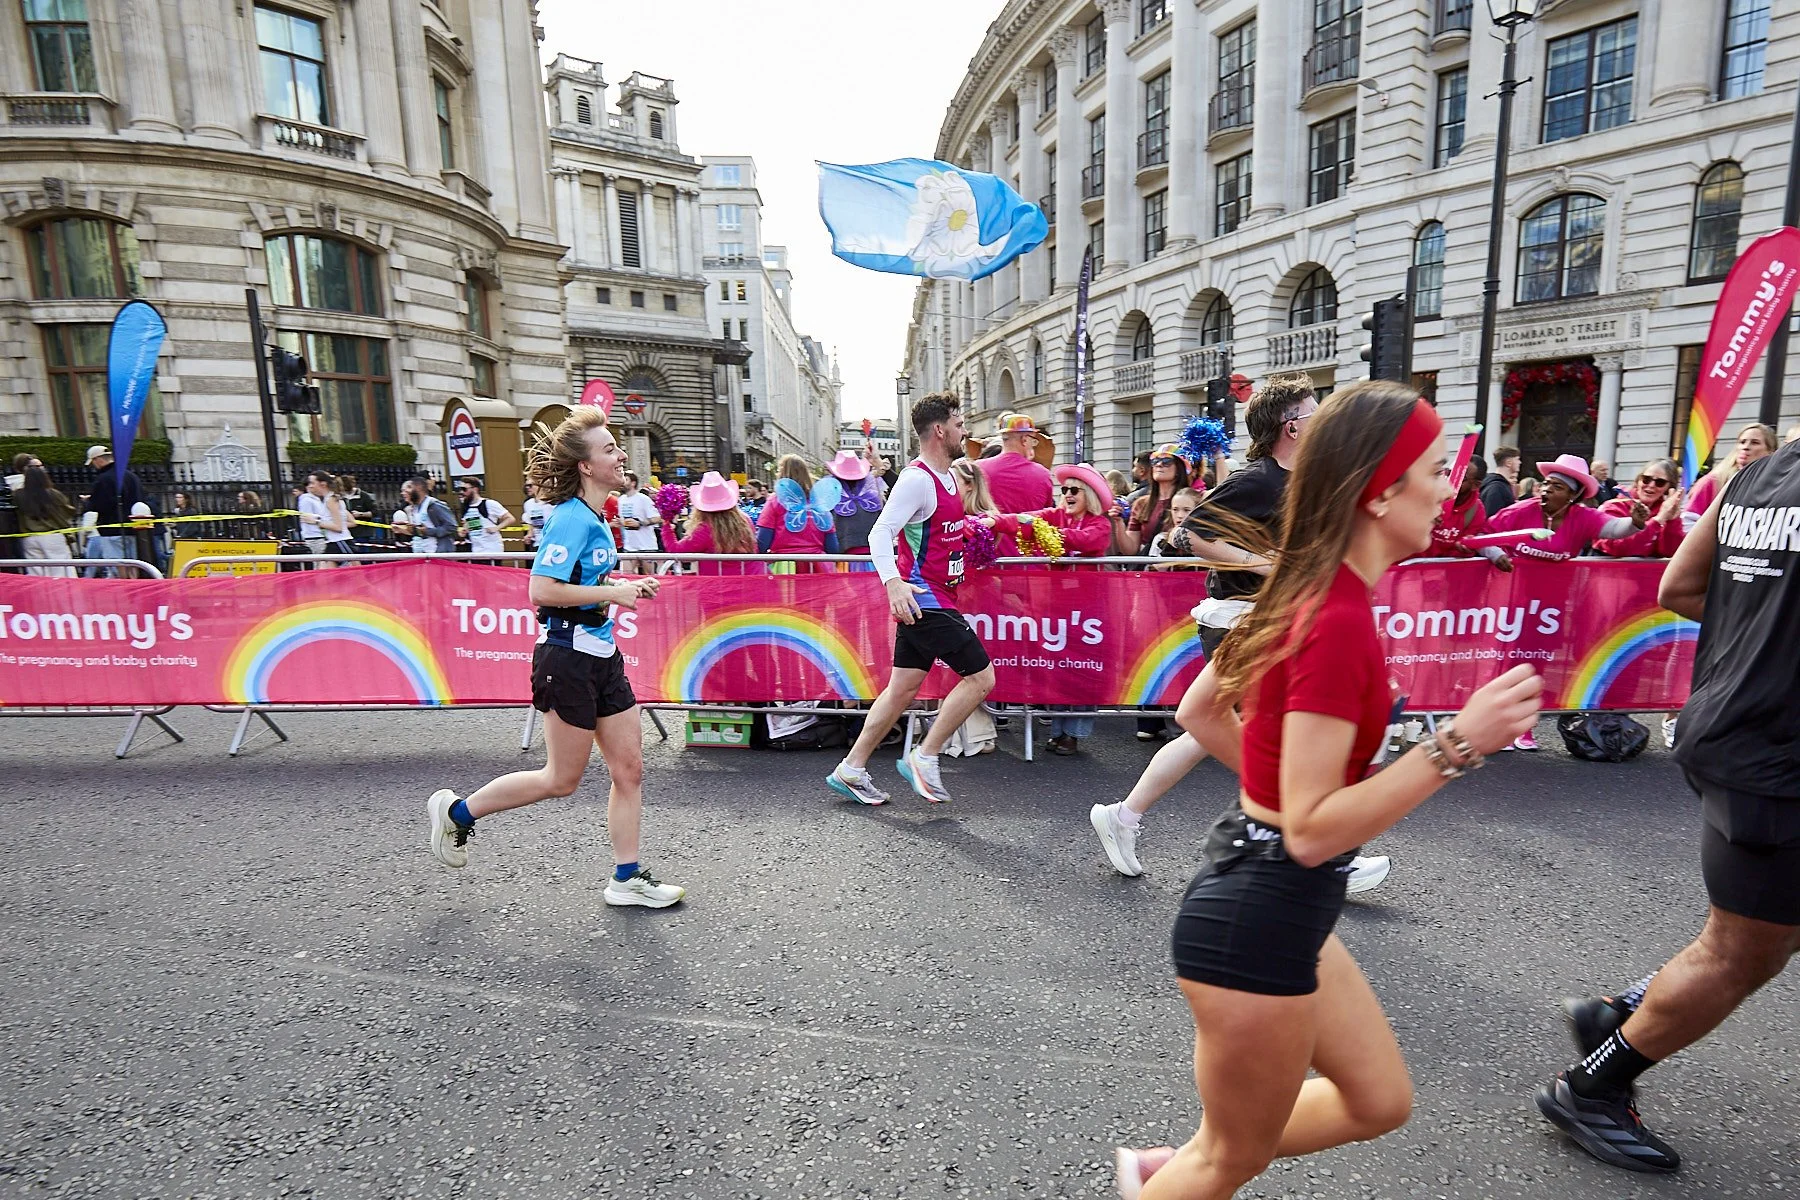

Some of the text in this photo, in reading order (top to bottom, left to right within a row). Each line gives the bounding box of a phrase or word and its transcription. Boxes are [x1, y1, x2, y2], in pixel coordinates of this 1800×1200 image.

[1504, 320, 1617, 342] LOMBARD STREET
[1504, 340, 1546, 348] RESTAURANT
[1577, 332, 1616, 341] BRASSERIE
[1710, 260, 1785, 379] Tommy's
[1735, 333, 1760, 376] pregnancy
[1756, 319, 1768, 335] and
[1764, 298, 1780, 319] baby
[1718, 502, 1800, 552] GYMSHAR
[0, 604, 194, 650] Tommy's
[452, 598, 639, 640] Tom's
[962, 610, 1104, 652] mmy's
[1372, 599, 1562, 643] Tommy's
[18, 655, 82, 668] pregnancy
[84, 655, 110, 666] and
[112, 655, 147, 668] baby
[150, 654, 198, 668] charity
[454, 647, 533, 663] The pregnancy
[993, 656, 1104, 672] and baby charity
[1385, 648, 1555, 667] pregnancy and baby charity
